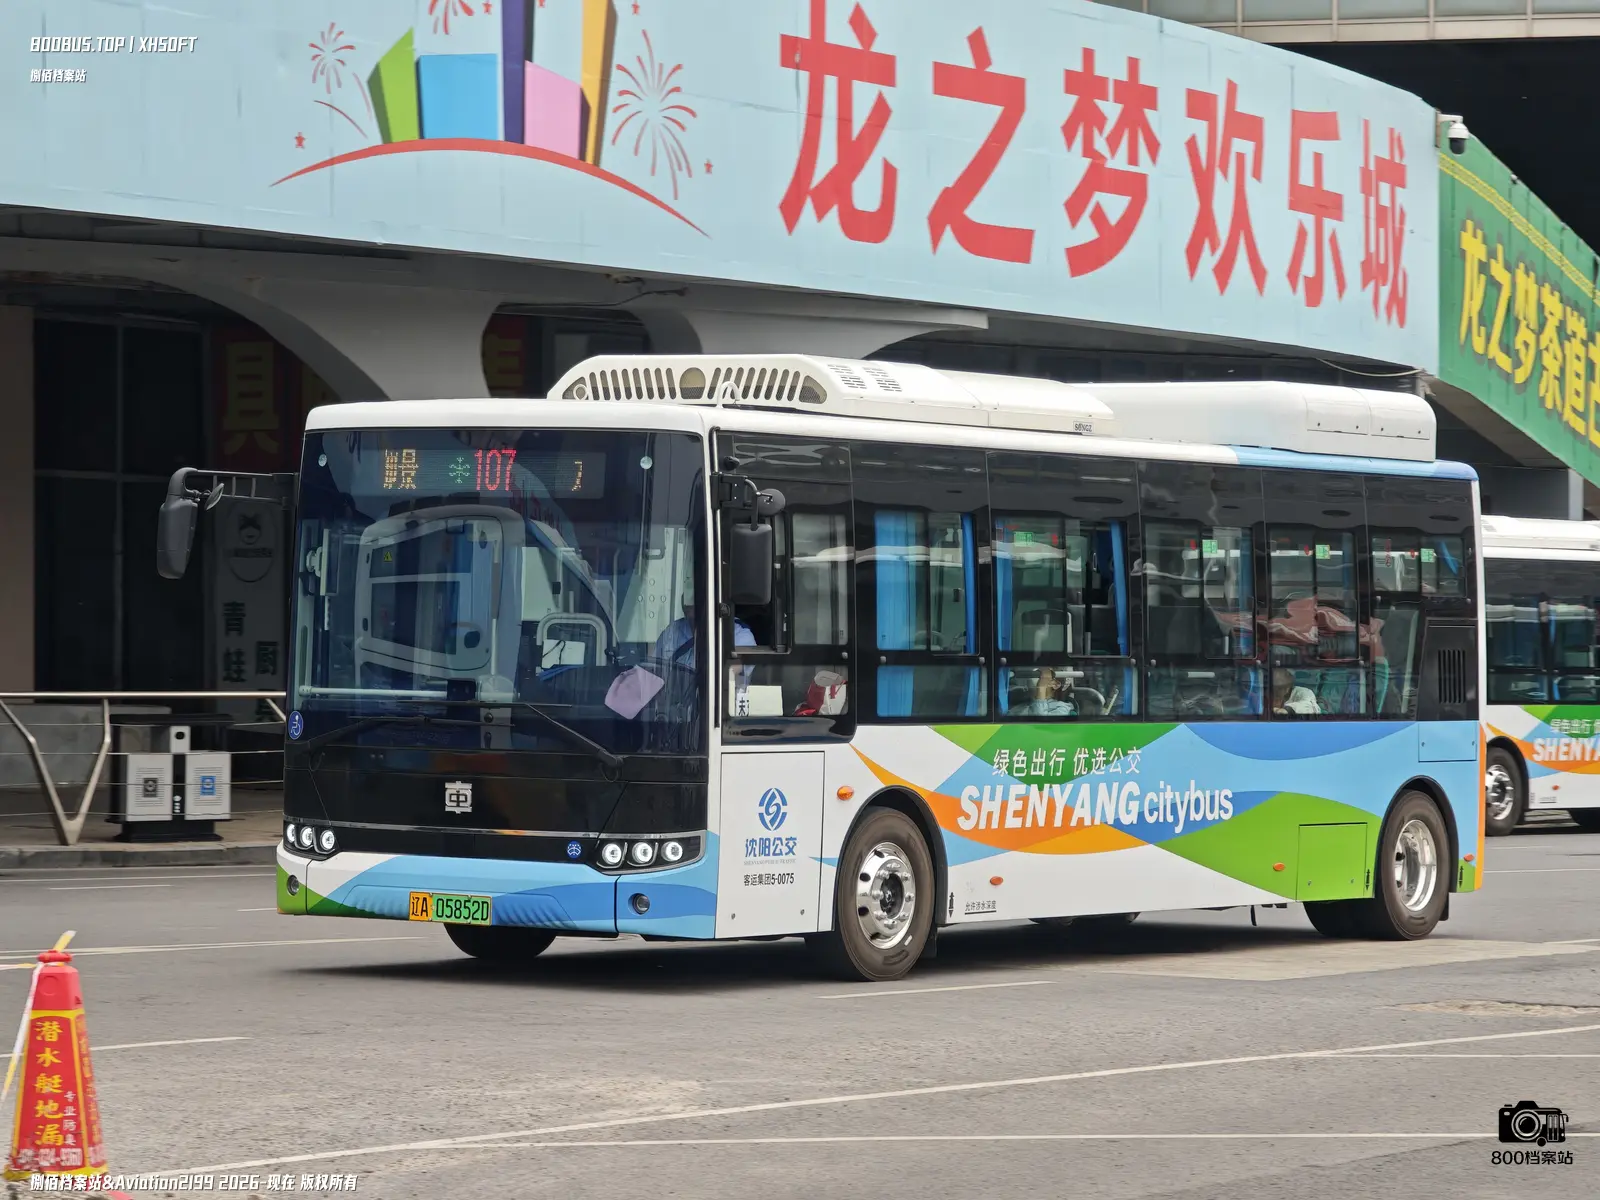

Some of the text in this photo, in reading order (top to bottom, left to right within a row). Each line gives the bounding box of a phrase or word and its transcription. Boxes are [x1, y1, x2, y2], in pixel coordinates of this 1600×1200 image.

[779, 0, 1408, 329] 龙之梦欢乐城
[475, 449, 516, 491] 107
[992, 746, 1142, 778] 绿色出行 优选公交
[957, 780, 1234, 833] SHENYANG citybus
[745, 836, 797, 857] 沈阳公交
[34, 1021, 64, 1146] 潜水艇地漏
